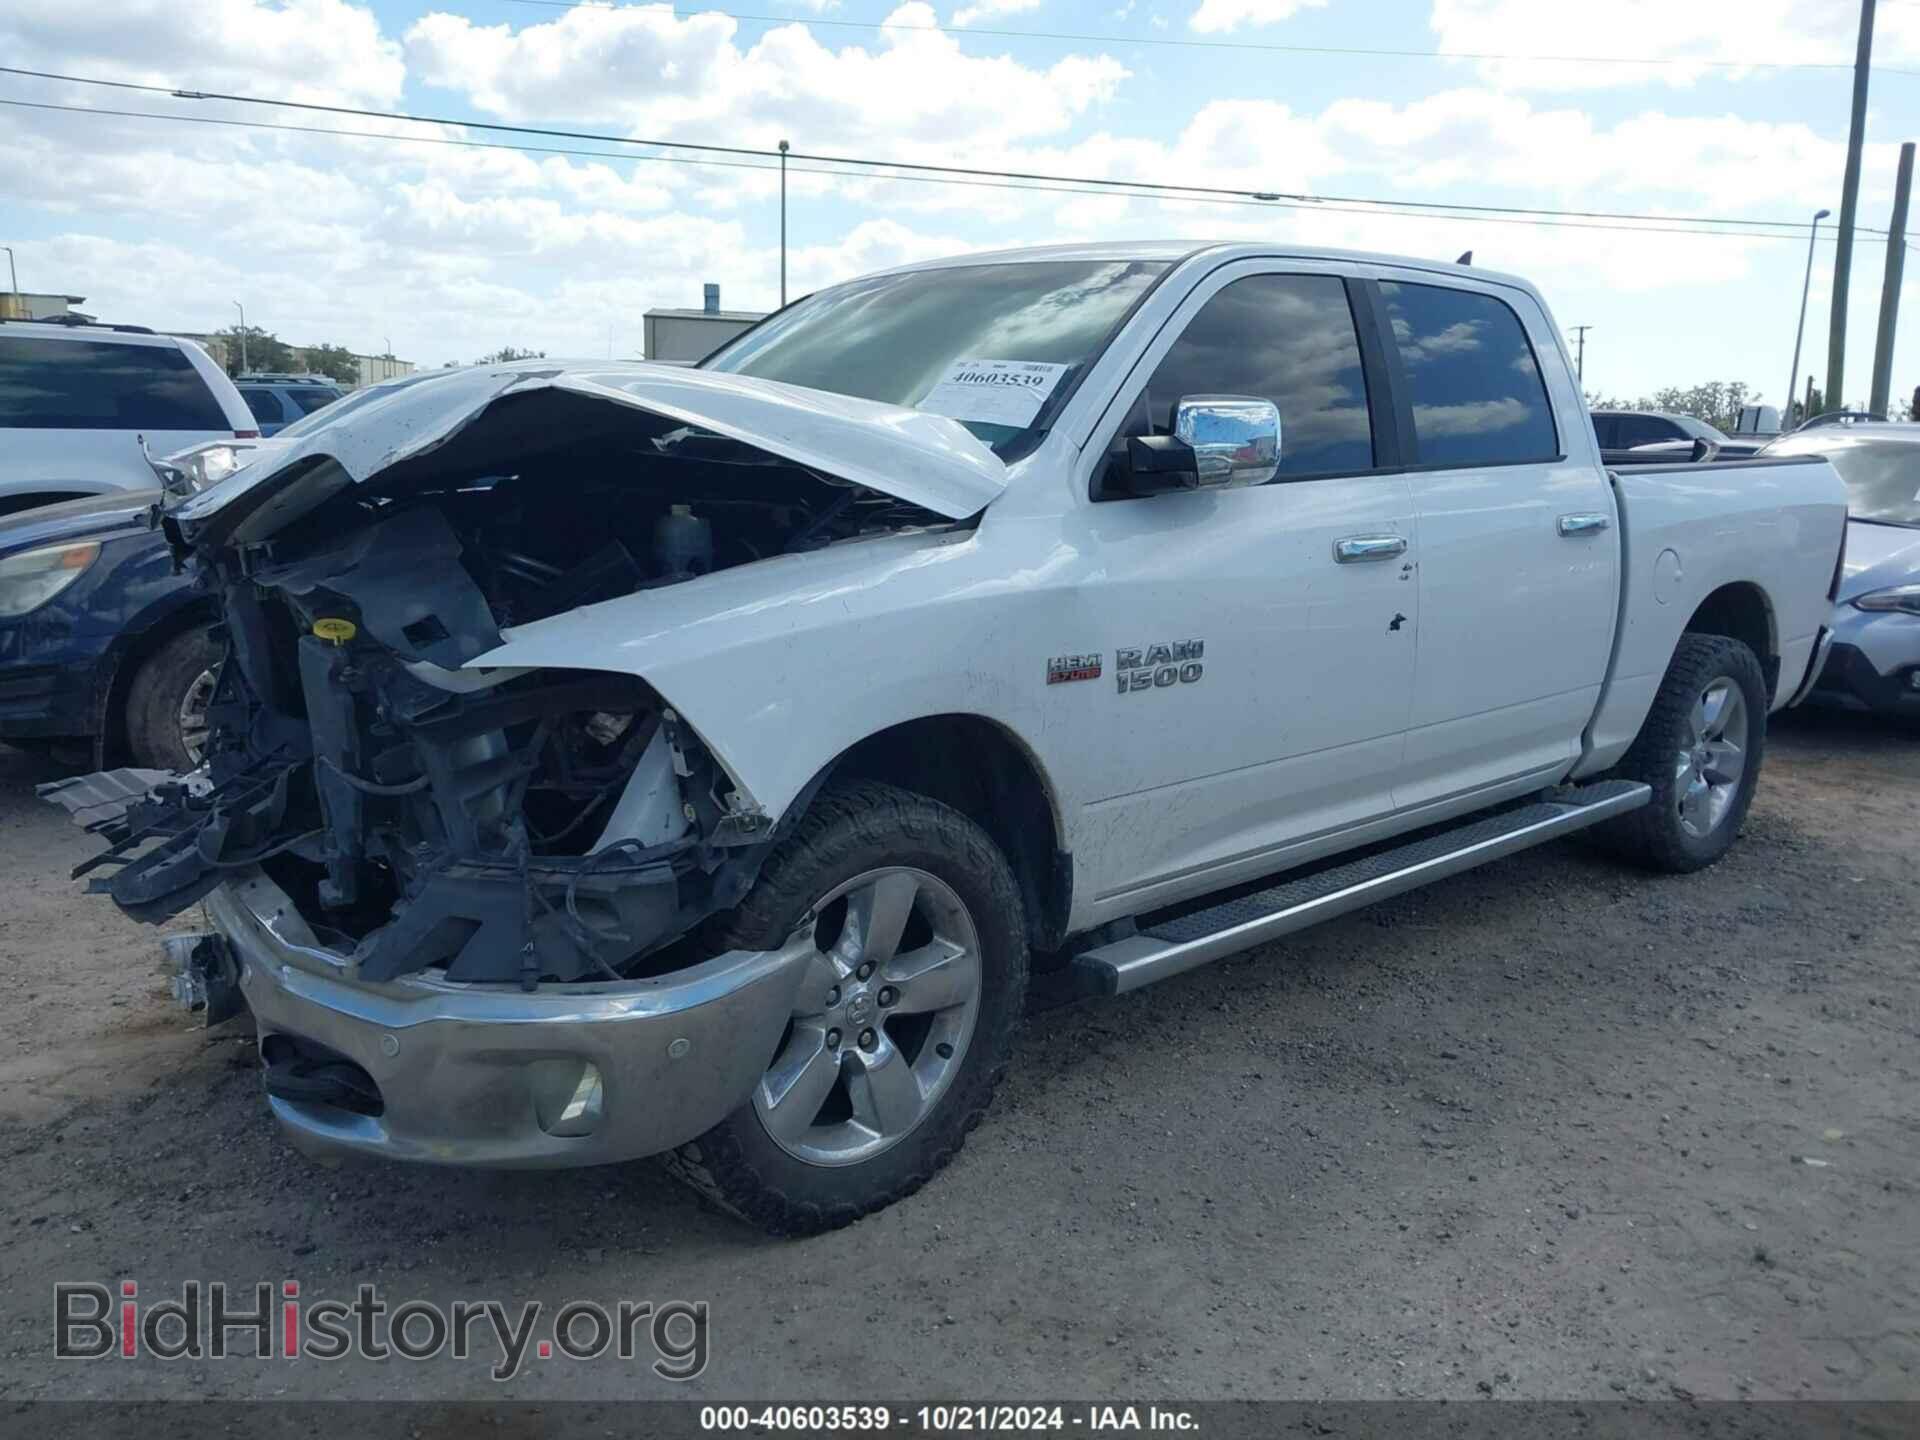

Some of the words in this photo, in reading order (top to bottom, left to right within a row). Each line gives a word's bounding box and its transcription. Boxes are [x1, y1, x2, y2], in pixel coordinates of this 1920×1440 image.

[953, 371, 1044, 387] 40603539
[1047, 654, 1102, 672] HEMI
[1116, 639, 1205, 671] RAM
[1116, 662, 1204, 694] 1500
